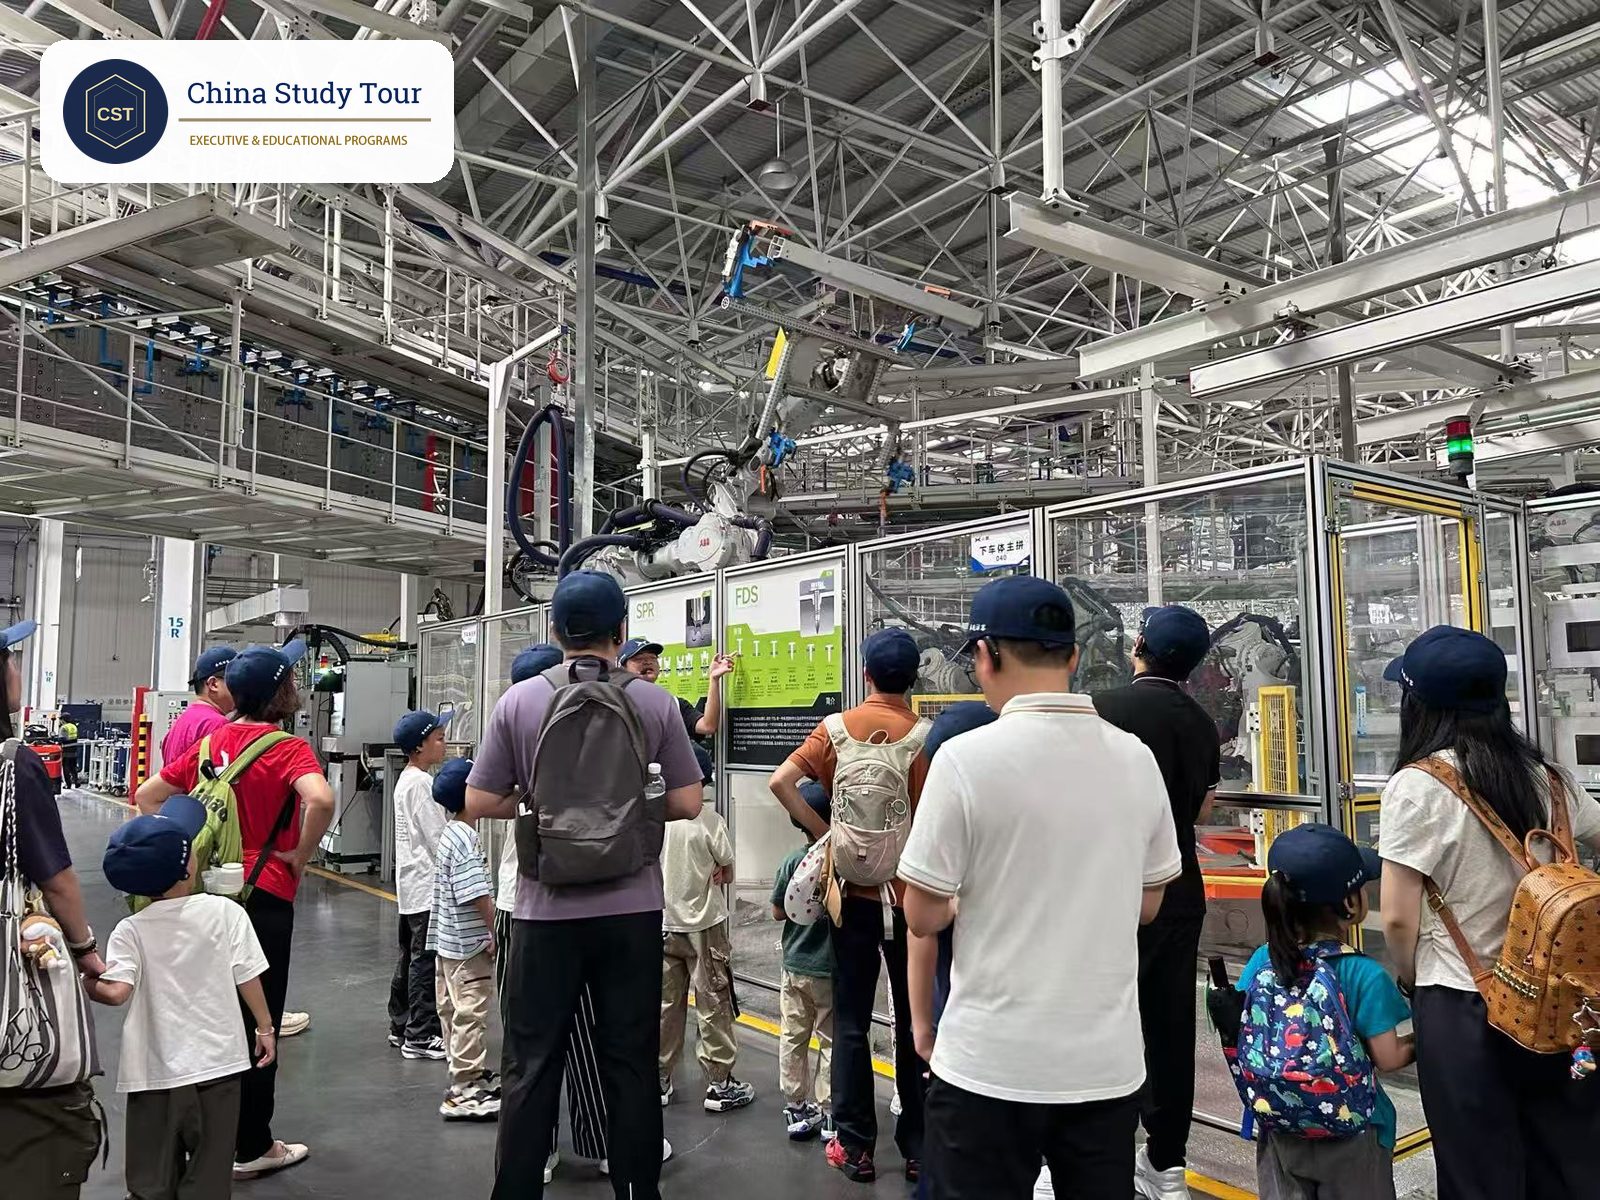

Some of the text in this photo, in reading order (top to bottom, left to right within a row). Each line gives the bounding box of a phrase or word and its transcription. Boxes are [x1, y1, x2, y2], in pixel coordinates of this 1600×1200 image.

[736, 585, 759, 605] FDS
[636, 601, 655, 619] SPR
[168, 616, 184, 628] 15
[170, 628, 180, 638] R
